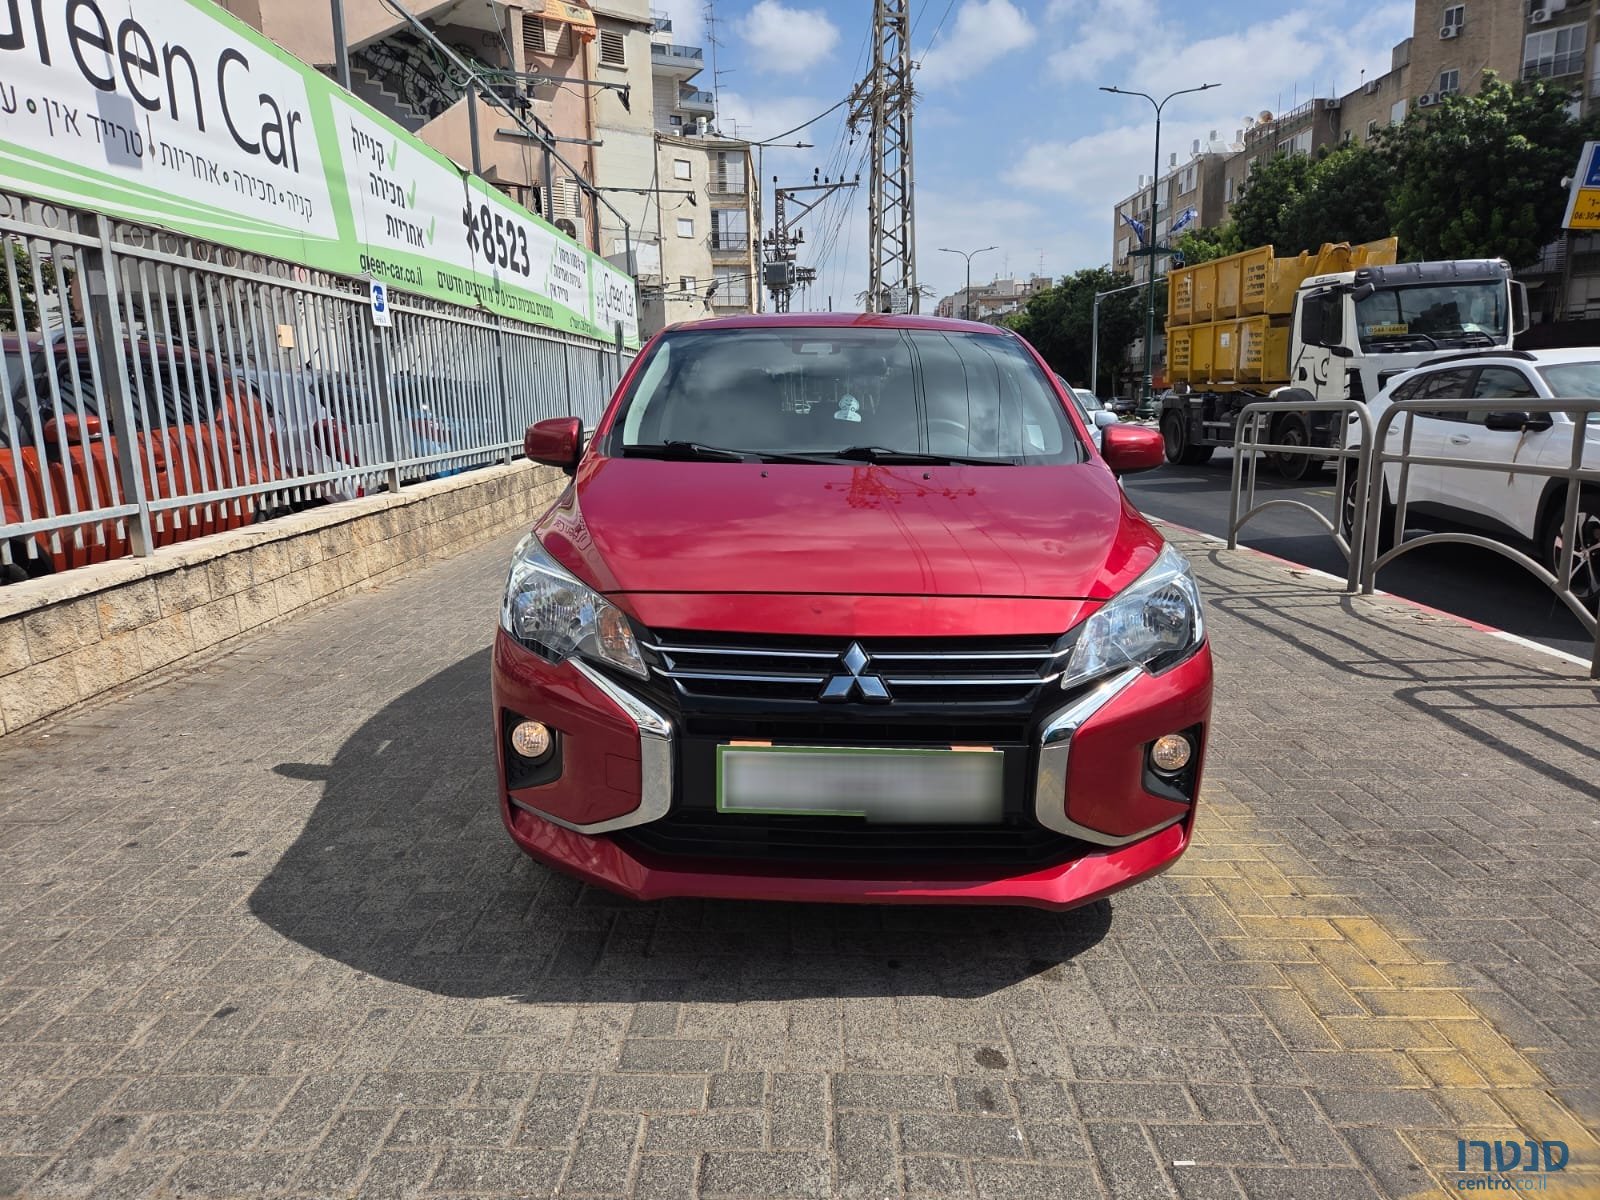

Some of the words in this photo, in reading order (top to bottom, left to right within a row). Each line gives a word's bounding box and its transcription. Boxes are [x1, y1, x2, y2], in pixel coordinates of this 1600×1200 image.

[42, 96, 82, 137] אין
[217, 47, 302, 174] Car
[87, 113, 143, 158] טרייד
[351, 126, 385, 171] קנייה
[160, 141, 221, 186] אחריות
[233, 169, 277, 205] מכירה
[369, 172, 405, 209] מכירה
[286, 190, 313, 223] קניה
[385, 213, 424, 248] אחריות
[359, 253, 423, 286] green-car.co.il
[437, 270, 464, 295] חדשים
